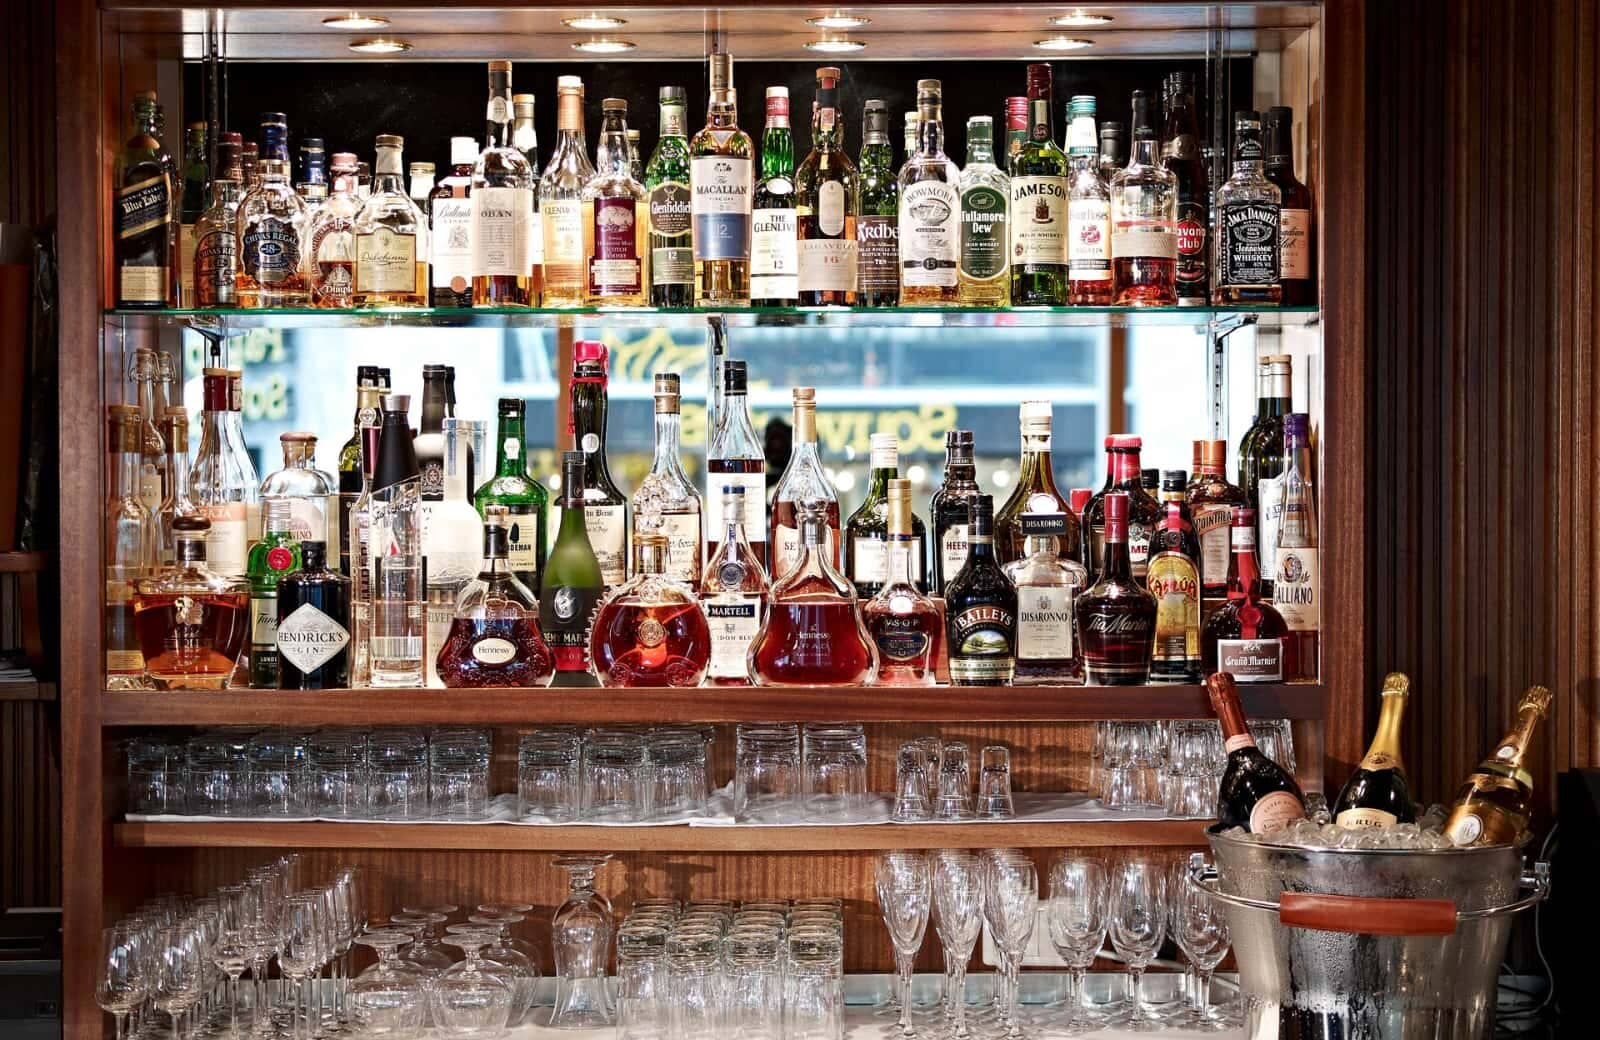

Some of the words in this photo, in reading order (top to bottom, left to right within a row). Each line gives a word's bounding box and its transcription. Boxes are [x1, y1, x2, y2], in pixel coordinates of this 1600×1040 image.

[696, 184, 748, 195] MACALLAN
[1014, 183, 1066, 201] JAMESON
[121, 199, 144, 214] Blue
[480, 208, 513, 218] OBAN
[769, 214, 787, 222] THE
[961, 210, 1005, 222] Tullamore
[1227, 209, 1248, 227] JACK
[753, 222, 797, 233] GLENLIV
[857, 221, 900, 242] Ardbe
[971, 222, 993, 234] Dew
[1176, 226, 1206, 238] avana
[272, 232, 298, 245] REGAL
[1177, 237, 1200, 249] Club
[1232, 254, 1273, 262] WHISKEY
[1025, 519, 1064, 528] DISARONNO
[711, 607, 751, 617] MARTELL
[957, 608, 1013, 628] BAILEYS
[1021, 611, 1069, 623] DISARONNO
[278, 631, 343, 643] HENDRICK'S
[297, 647, 321, 655] GIN
